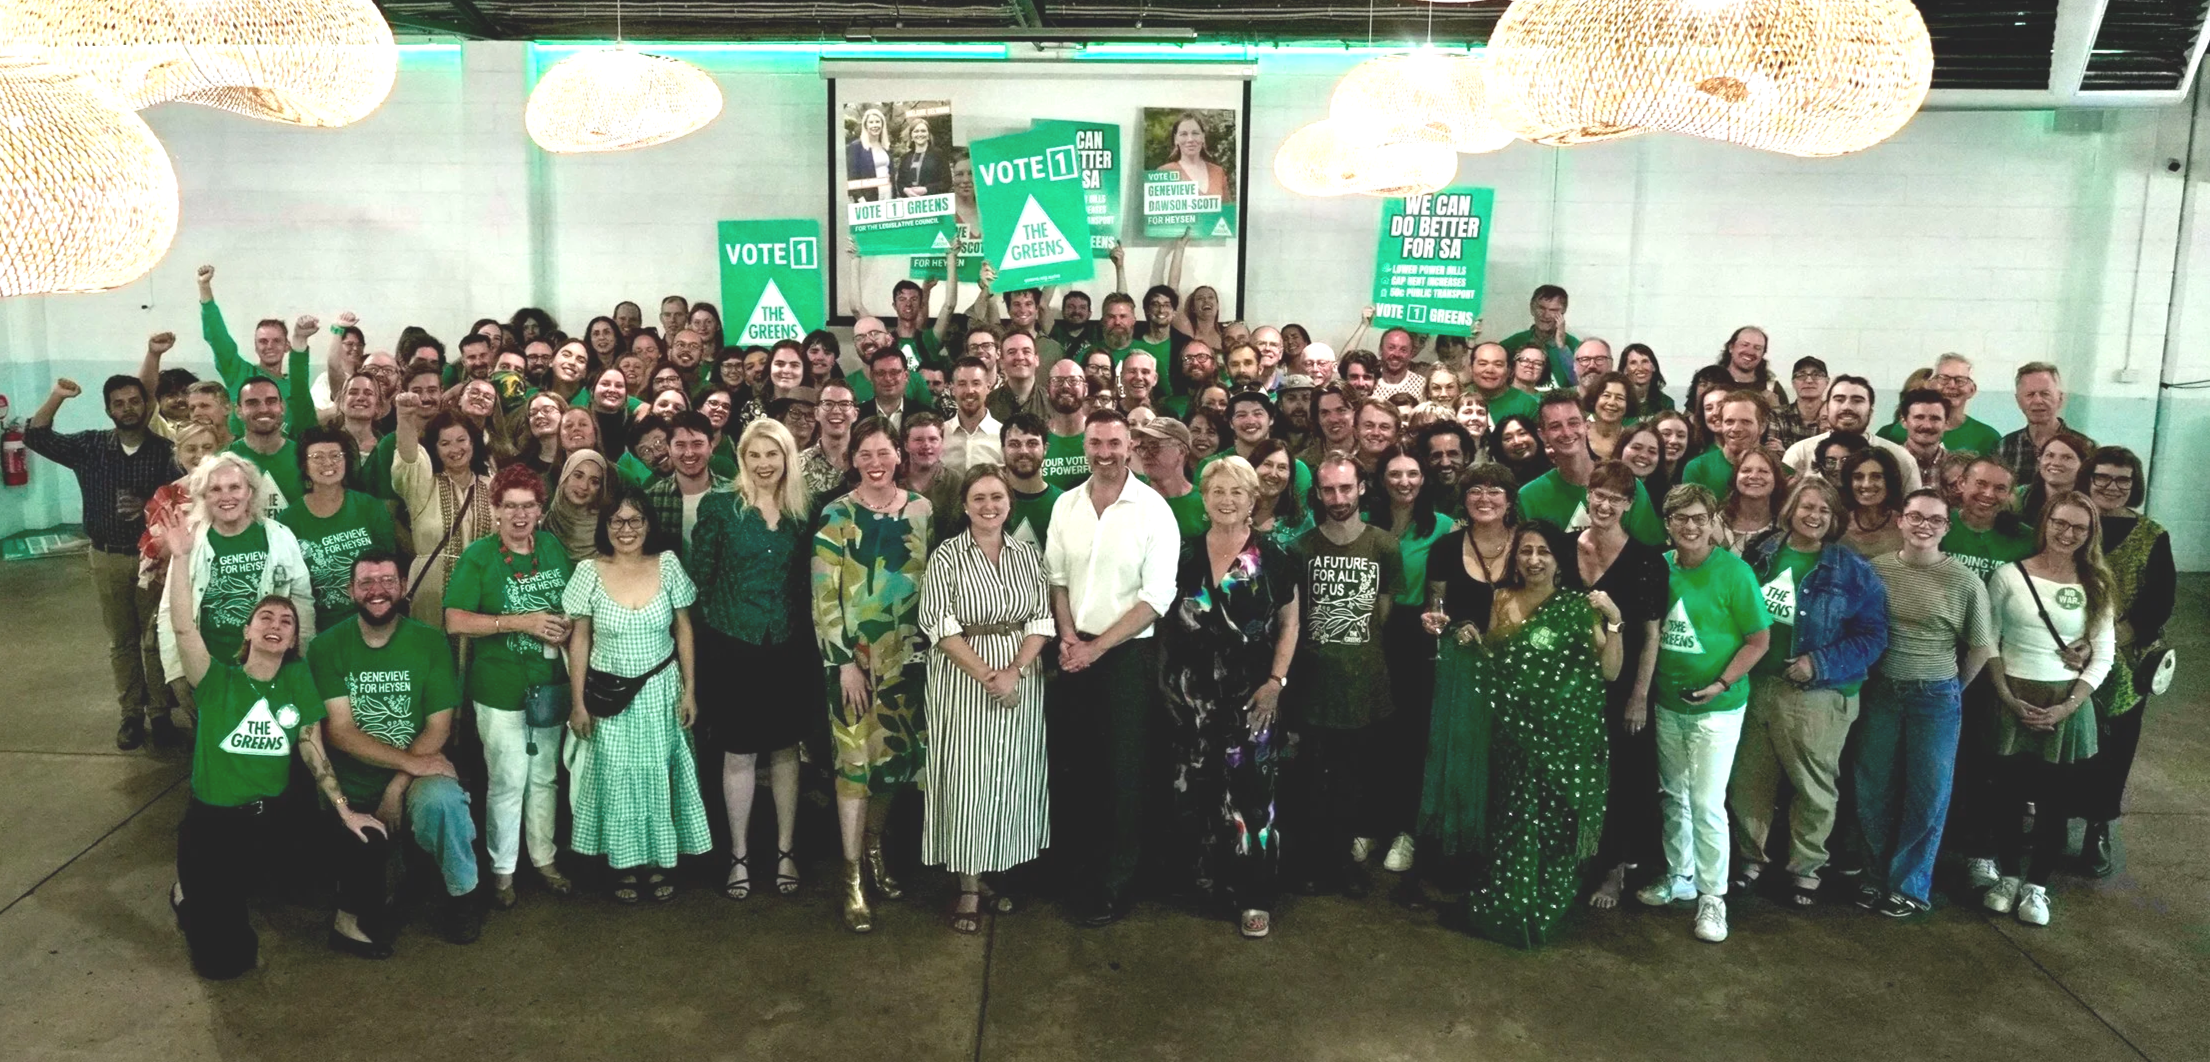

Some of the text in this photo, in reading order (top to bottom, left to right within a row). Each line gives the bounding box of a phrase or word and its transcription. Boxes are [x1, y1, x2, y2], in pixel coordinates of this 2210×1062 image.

[1076, 130, 1103, 150] CAN
[1080, 150, 1112, 170] TTER
[979, 156, 1045, 186] VOTE
[1082, 170, 1100, 188] SA
[1148, 172, 1168, 180] VOTE
[1148, 184, 1196, 196] GENEVIEVE
[855, 204, 882, 220] VOTE
[907, 197, 949, 215] GREENS
[1149, 198, 1220, 212] DAWSON-SCOTT
[1404, 194, 1472, 216] WE CAN
[878, 220, 914, 230] LEGISLATIVE
[1164, 215, 1196, 224] HEYSEN
[1390, 216, 1480, 238] DO BETTER
[1022, 222, 1048, 240] THE
[1011, 238, 1064, 261] GREENS
[1090, 235, 1115, 248] EENS
[1402, 238, 1462, 259] FOR SA
[725, 243, 788, 265] VOTE
[914, 258, 964, 268] FOR HEYEN
[1392, 264, 1418, 274] LOWER
[1418, 265, 1446, 275] POWER
[761, 306, 785, 322] THE
[1376, 303, 1404, 319] VOTE
[1429, 309, 1474, 326] GREENS
[748, 324, 798, 340] GREENS
[1042, 456, 1089, 468] YOUR VOTE
[1050, 465, 1093, 476] POWERF
[322, 527, 368, 546] GENEVIEVE
[324, 536, 372, 555] FOR HEYSEN
[220, 561, 266, 574] FOR HEYSE
[1314, 556, 1368, 570] A FUTURE
[1952, 553, 1989, 568] NDING
[517, 568, 562, 584] GENEVIEVE
[1314, 569, 1358, 584] FOR ALL
[520, 584, 538, 592] FOR
[1312, 583, 1345, 596] OF US
[1766, 586, 1790, 602] THE
[2064, 588, 2076, 597] NO
[1764, 599, 1792, 618] EENS
[1668, 620, 1686, 633] THE
[1662, 632, 1694, 648] REENS
[360, 670, 410, 682] GENEVIEVE
[360, 682, 411, 694] FOR HEYSEN
[248, 720, 271, 736] THE
[230, 733, 284, 750] GREENS
